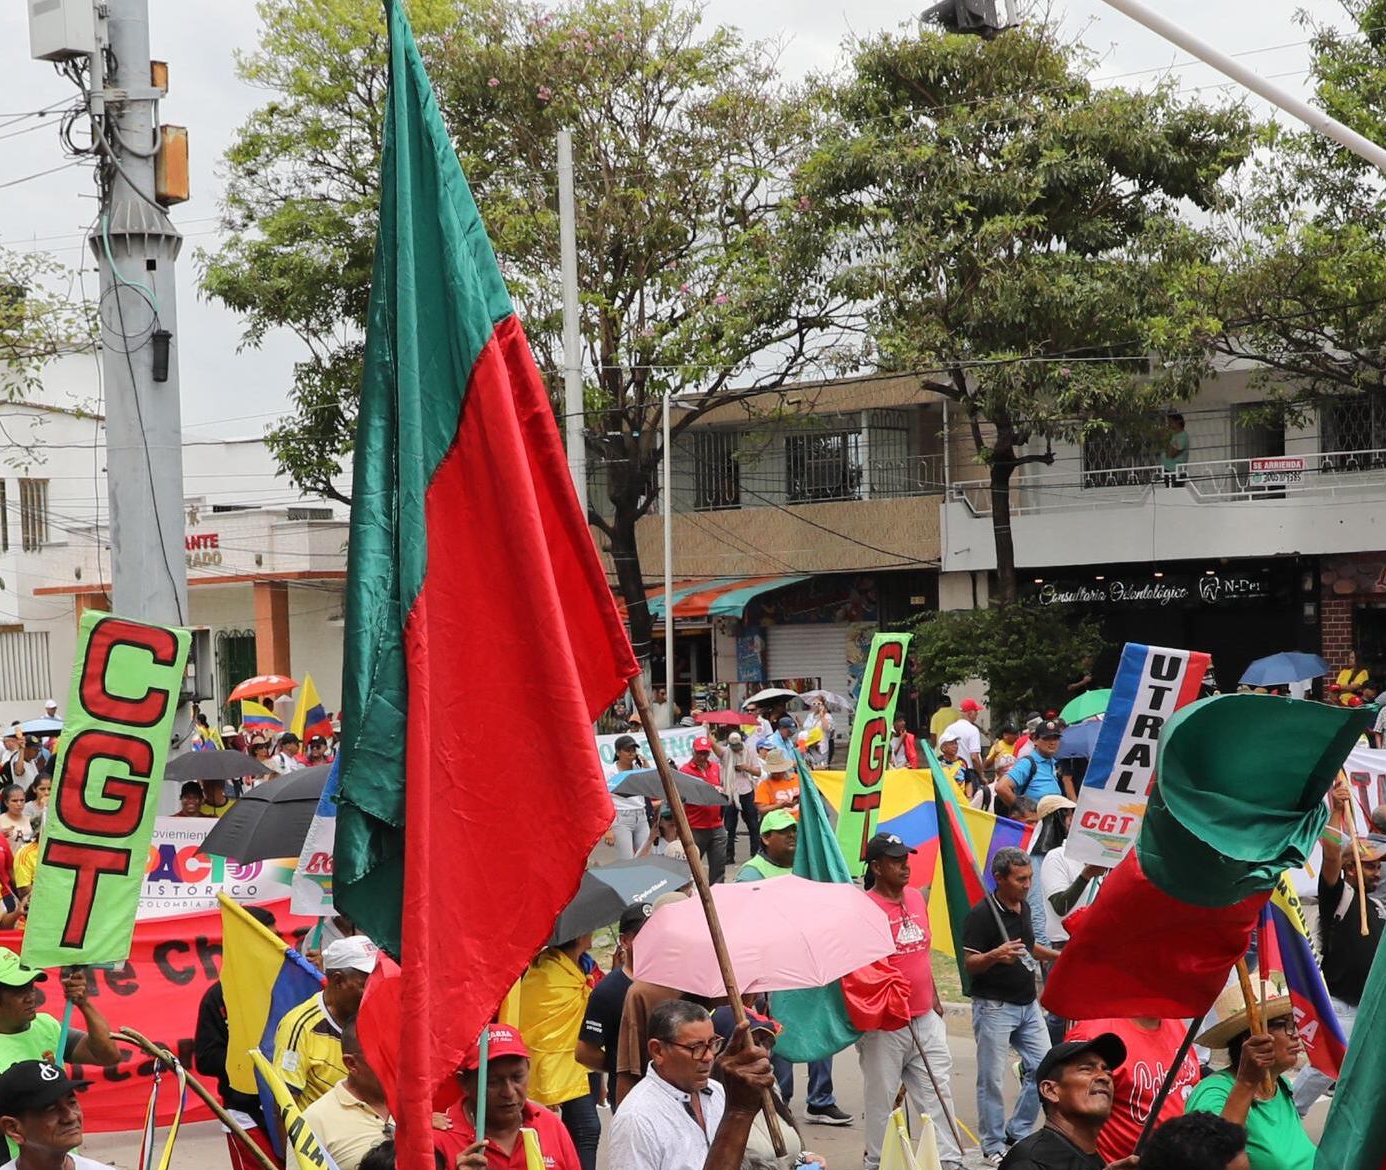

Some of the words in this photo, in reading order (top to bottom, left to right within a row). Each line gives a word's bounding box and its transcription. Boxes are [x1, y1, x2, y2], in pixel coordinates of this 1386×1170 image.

[42, 616, 179, 950] CGT
[850, 640, 905, 864] CGT
[1115, 653, 1183, 795] UTRAL
[1079, 810, 1135, 835] CGT
